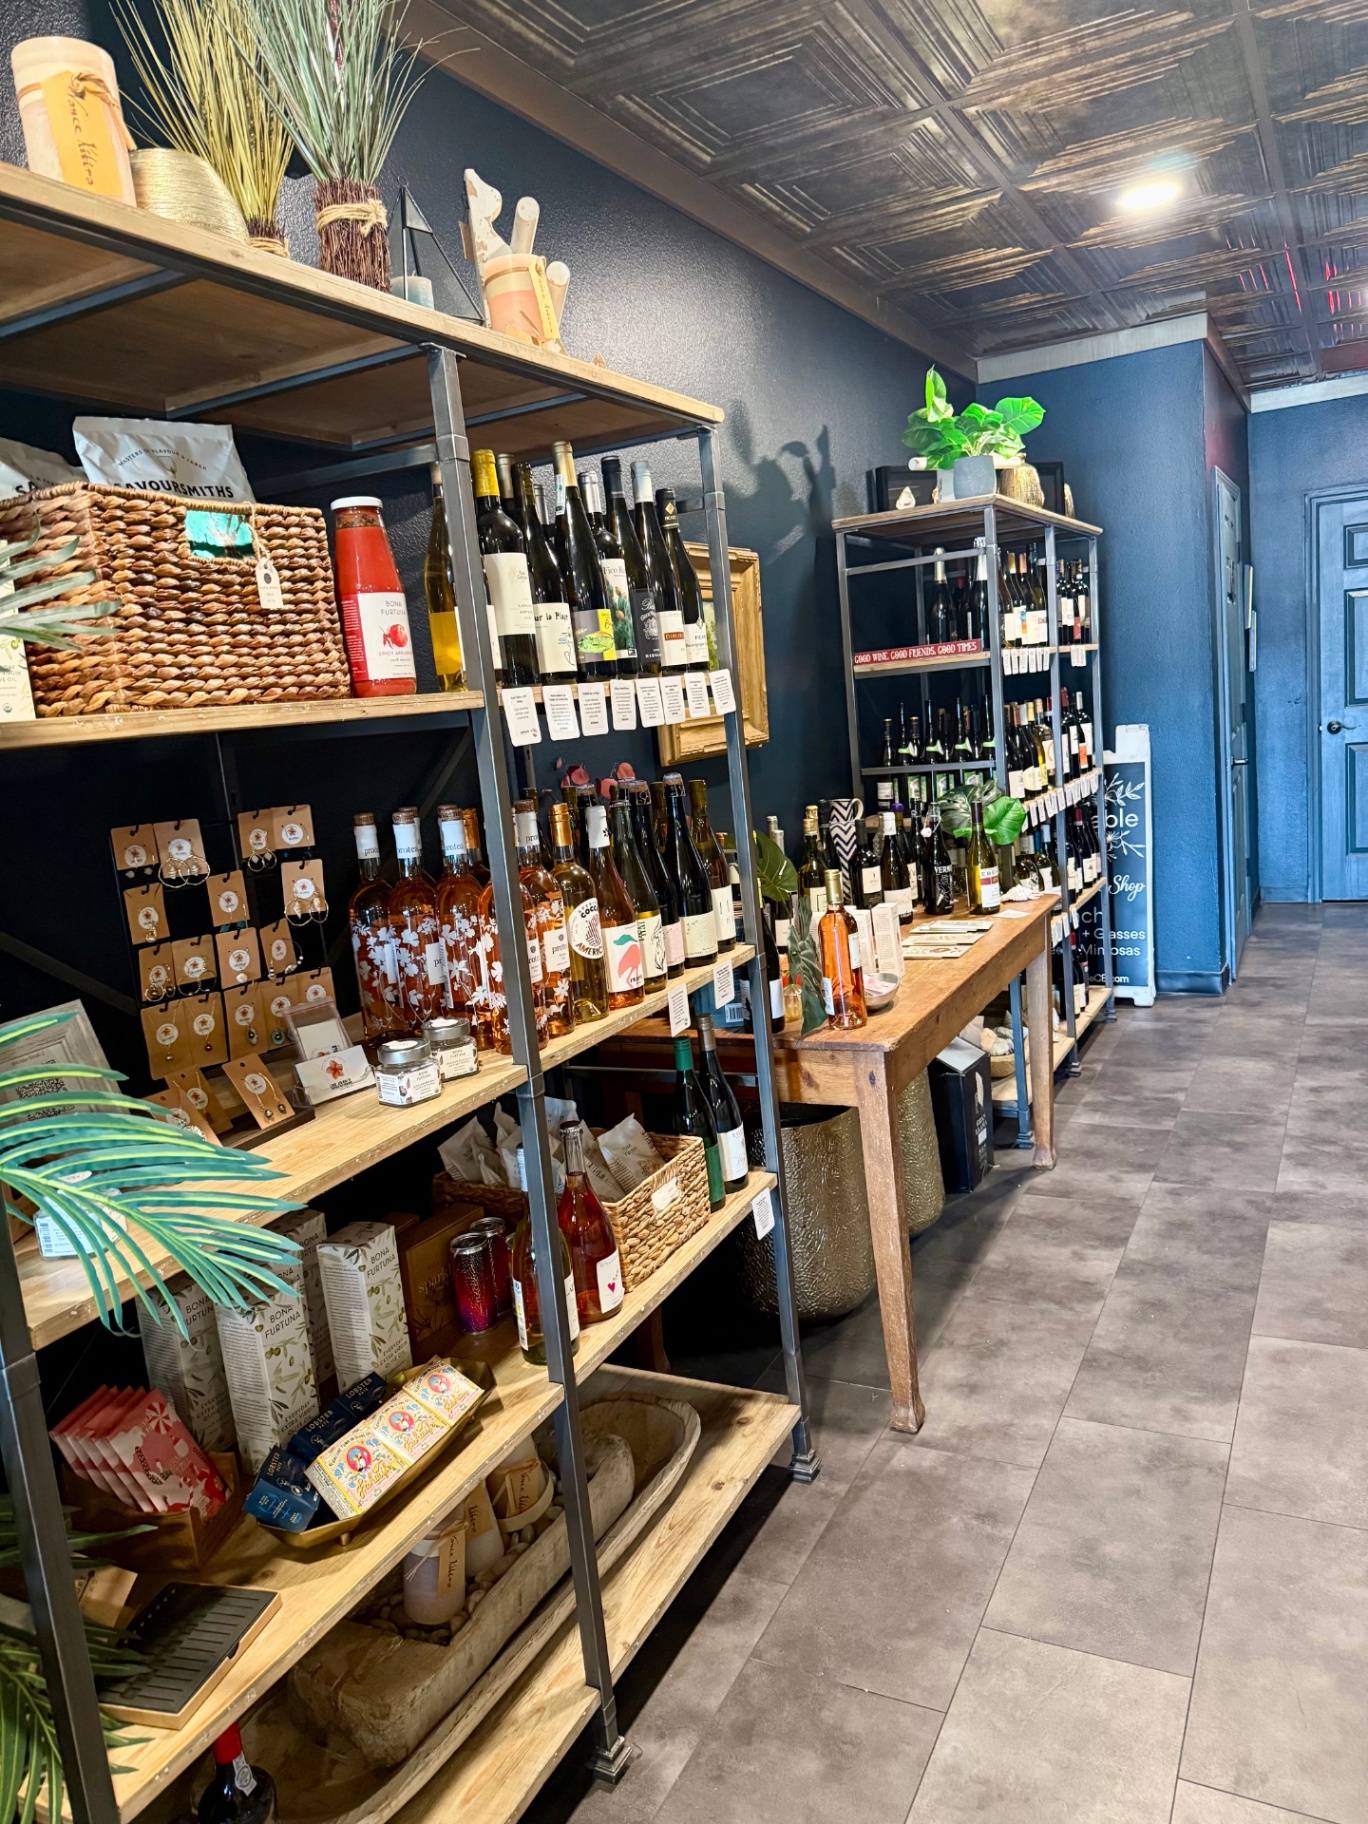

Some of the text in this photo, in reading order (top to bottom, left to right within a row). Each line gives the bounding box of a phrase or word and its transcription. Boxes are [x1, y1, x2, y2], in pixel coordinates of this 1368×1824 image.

[118, 450, 144, 467] MASTERS
[152, 448, 180, 456] FLAVOUR
[113, 479, 234, 499] AVOURSMITHS
[854, 653, 871, 664] GOOD
[890, 650, 908, 660] GOOD
[938, 645, 956, 655] GOOD
[957, 641, 977, 652] TIMES
[1108, 875, 1145, 902] Shop
[1093, 928, 1146, 940] Gasses
[366, 1253, 396, 1279] FURTUNA
[370, 1247, 390, 1265] BONA
[185, 1304, 214, 1326] URTUN
[264, 1312, 301, 1340] FURTUNA
[269, 1306, 294, 1324] BONA
[345, 1377, 373, 1399] LOBSTER
[305, 1409, 335, 1433] LOBSTER
[340, 1440, 350, 1450] TUNA
[266, 1452, 281, 1477] LOBSTER
